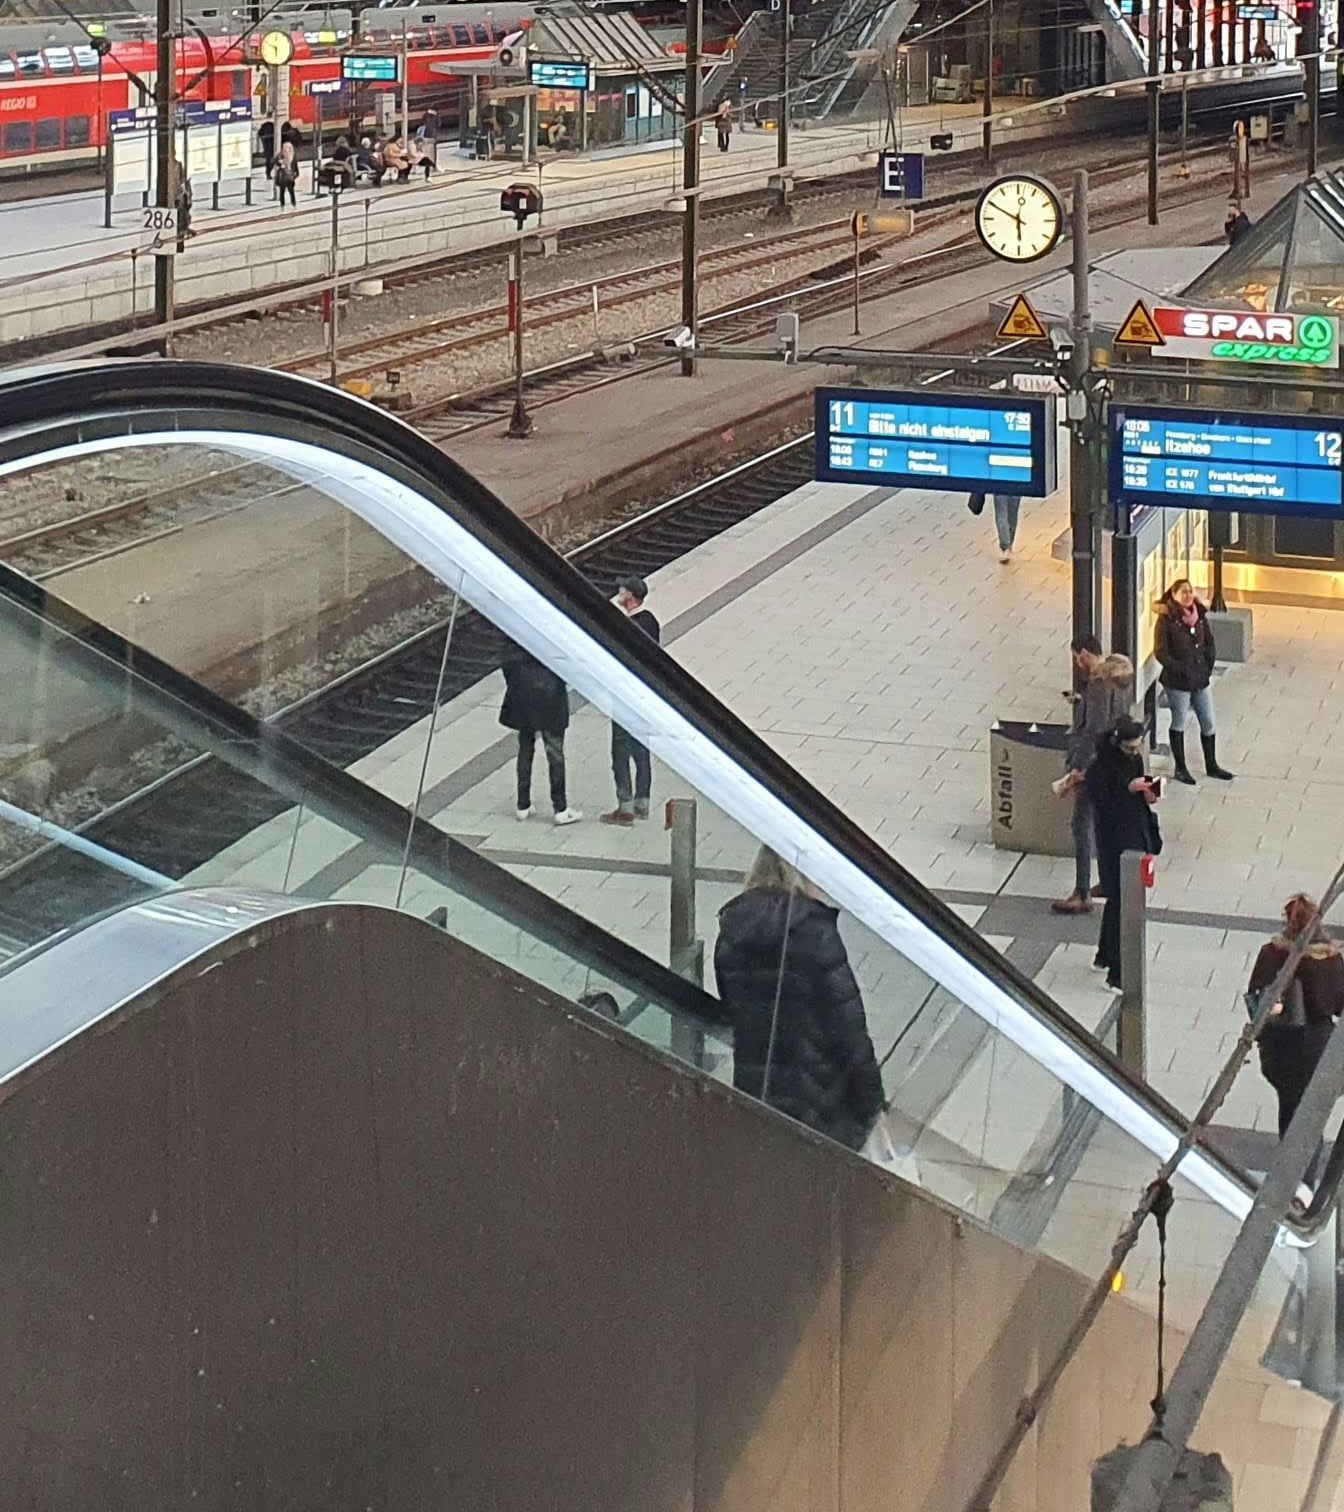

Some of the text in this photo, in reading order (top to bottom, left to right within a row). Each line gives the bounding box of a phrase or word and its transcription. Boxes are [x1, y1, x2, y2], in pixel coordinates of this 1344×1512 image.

[884, 157, 905, 191] E
[143, 209, 175, 230] 286
[1183, 312, 1293, 342] SPAR
[1211, 341, 1332, 363] express
[830, 401, 854, 426] 11
[868, 419, 896, 435] Bitte
[898, 422, 928, 438] nicht
[931, 424, 991, 443] einsteigen
[1165, 438, 1212, 456] Itzehoe
[1313, 431, 1342, 458] 12
[1227, 483, 1267, 497] Stuttgart
[997, 765, 1013, 830] Abfall
